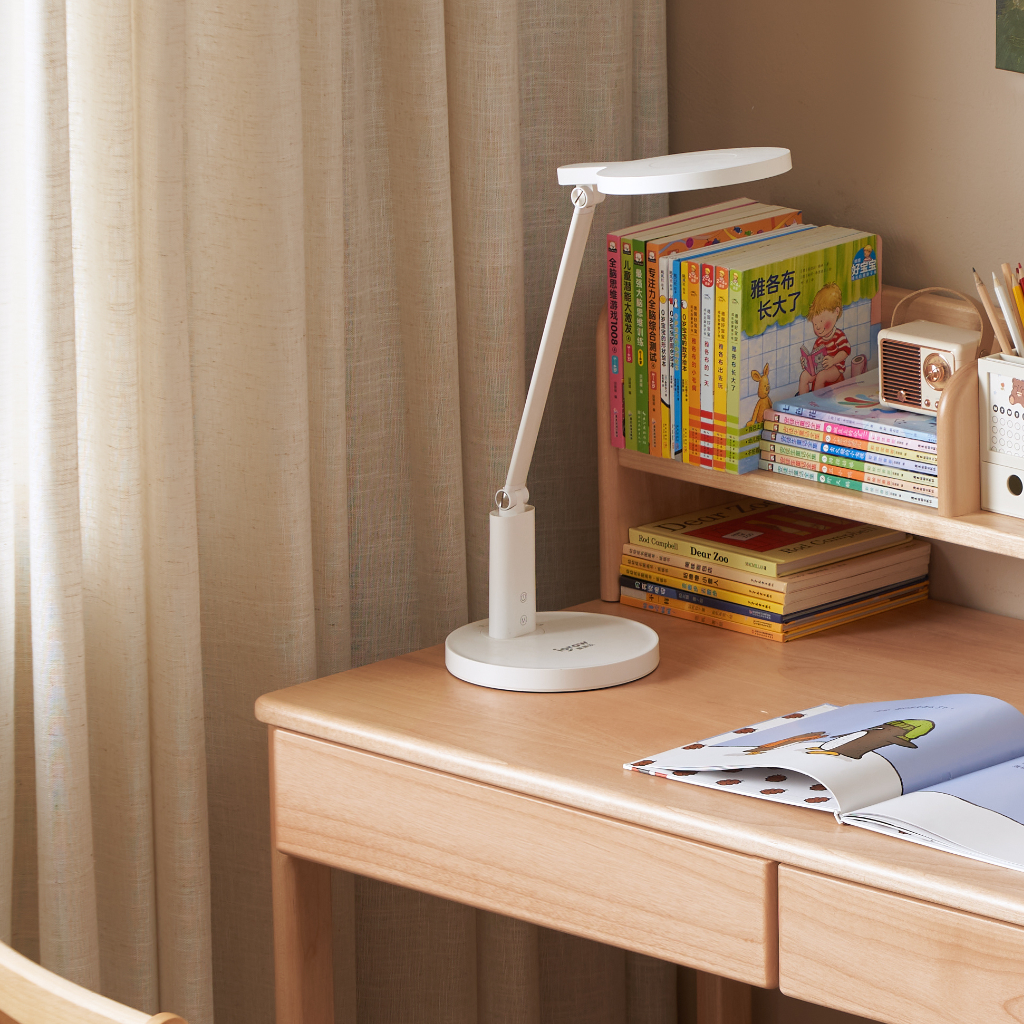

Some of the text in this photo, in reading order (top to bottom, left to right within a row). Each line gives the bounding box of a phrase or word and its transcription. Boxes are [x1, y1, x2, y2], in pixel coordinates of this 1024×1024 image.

[851, 259, 877, 276] 好宝宝
[750, 269, 796, 300] 雅各布
[757, 291, 801, 321] 长大了
[655, 510, 724, 532] Dear
[638, 534, 678, 551] Rod Campbell
[690, 546, 729, 564] Dear Zoo
